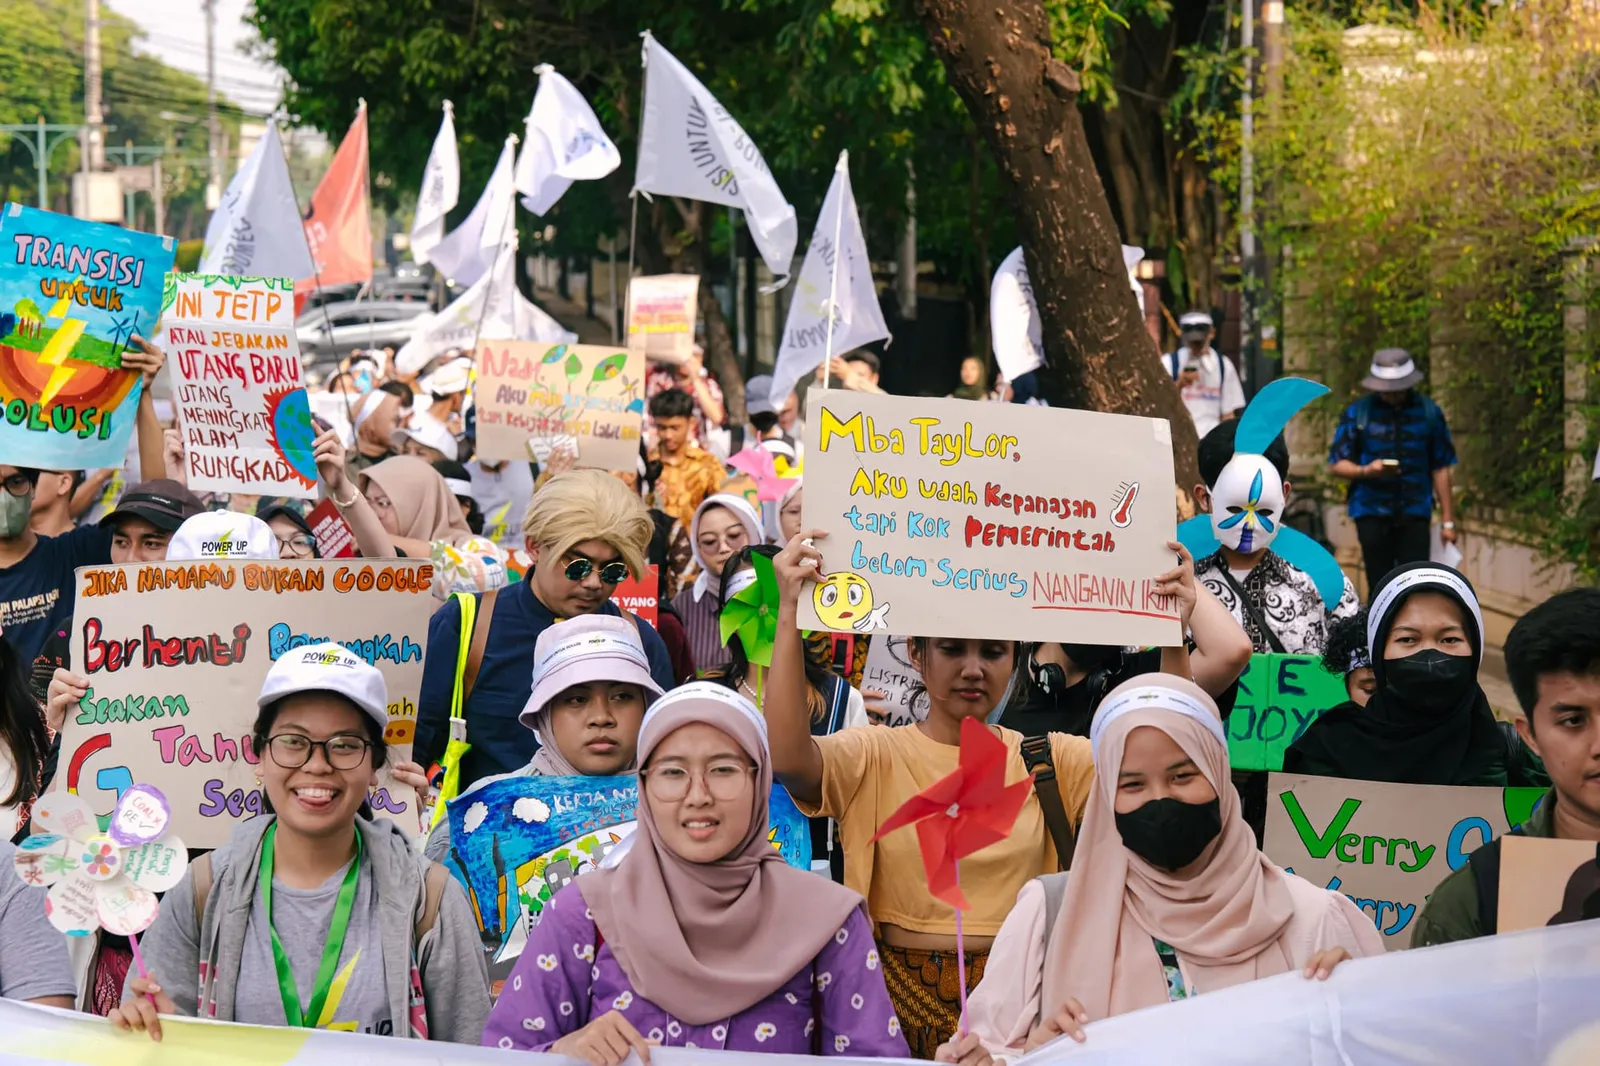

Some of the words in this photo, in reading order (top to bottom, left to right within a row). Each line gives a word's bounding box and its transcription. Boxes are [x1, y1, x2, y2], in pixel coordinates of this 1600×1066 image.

[13, 233, 145, 289] TRANSISI
[40, 277, 124, 312] untuk
[176, 291, 202, 320] INI
[213, 290, 283, 322] JETP
[169, 327, 207, 346] ATAU
[211, 331, 289, 350] JEBAKAN
[178, 350, 249, 392] UTANG
[250, 353, 299, 385] BARU
[179, 384, 233, 408] UTANG
[183, 407, 270, 433] MENINGKAT
[819, 406, 905, 455] Mba
[189, 428, 239, 449] ALAM
[189, 451, 290, 484] RUNGKAD
[984, 481, 1097, 519] Kepanasan
[843, 505, 897, 537] tapi
[201, 541, 233, 552] POWER
[236, 540, 248, 551] UP
[82, 568, 128, 597] JIKA
[137, 562, 236, 593] NAMAMU
[243, 563, 325, 594] BUKAN
[932, 557, 1028, 598] Serius
[1032, 571, 1136, 609] NANGANIN
[82, 616, 252, 675] Berhenti
[303, 651, 341, 663] POWER
[343, 657, 357, 666] UP
[132, 796, 154, 819] COAL
[553, 790, 607, 814] KERJA
[592, 801, 636, 818] BUKAN
[1280, 790, 1436, 872] Verry
